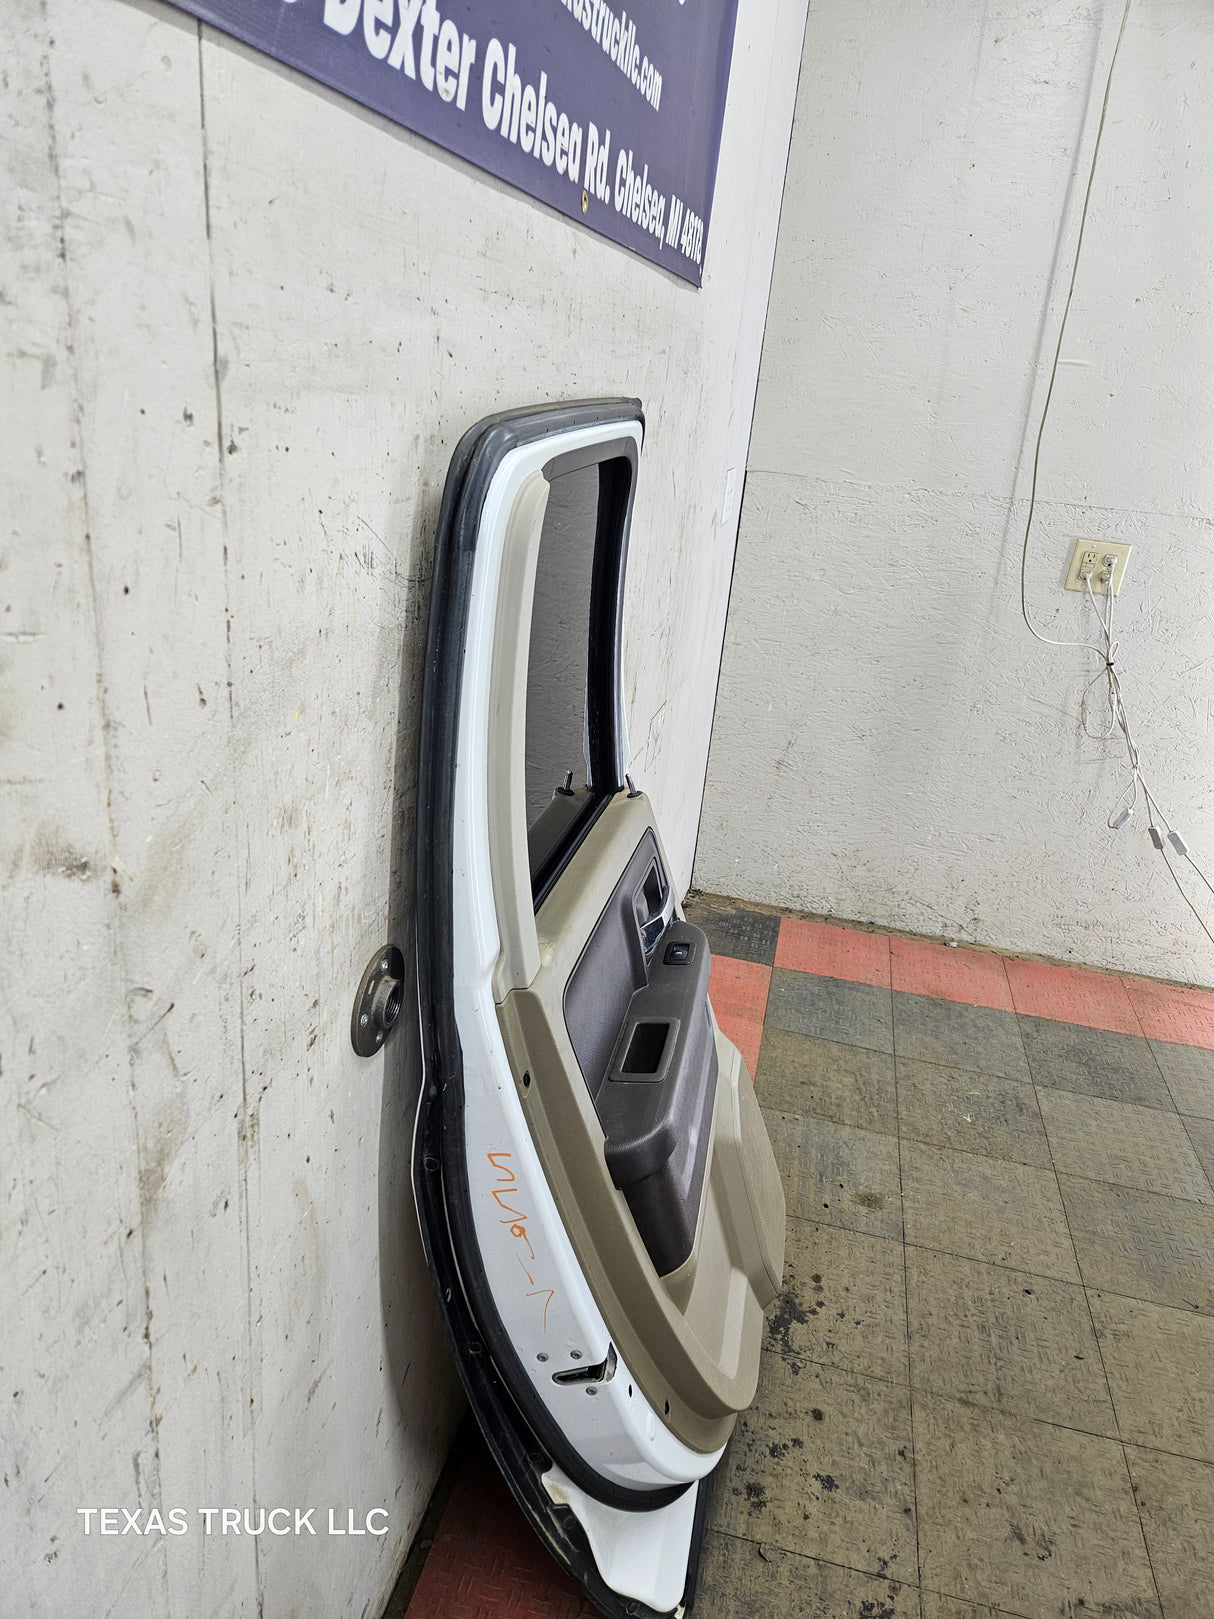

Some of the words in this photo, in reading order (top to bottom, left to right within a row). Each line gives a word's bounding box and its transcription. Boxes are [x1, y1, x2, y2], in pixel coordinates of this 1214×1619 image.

[323, 0, 477, 112] exter
[482, 38, 583, 184] Chelsea
[584, 121, 611, 205] Rd.
[614, 149, 666, 250] Chelsea,
[666, 194, 684, 249] MI
[561, 0, 663, 112] struckllc.com
